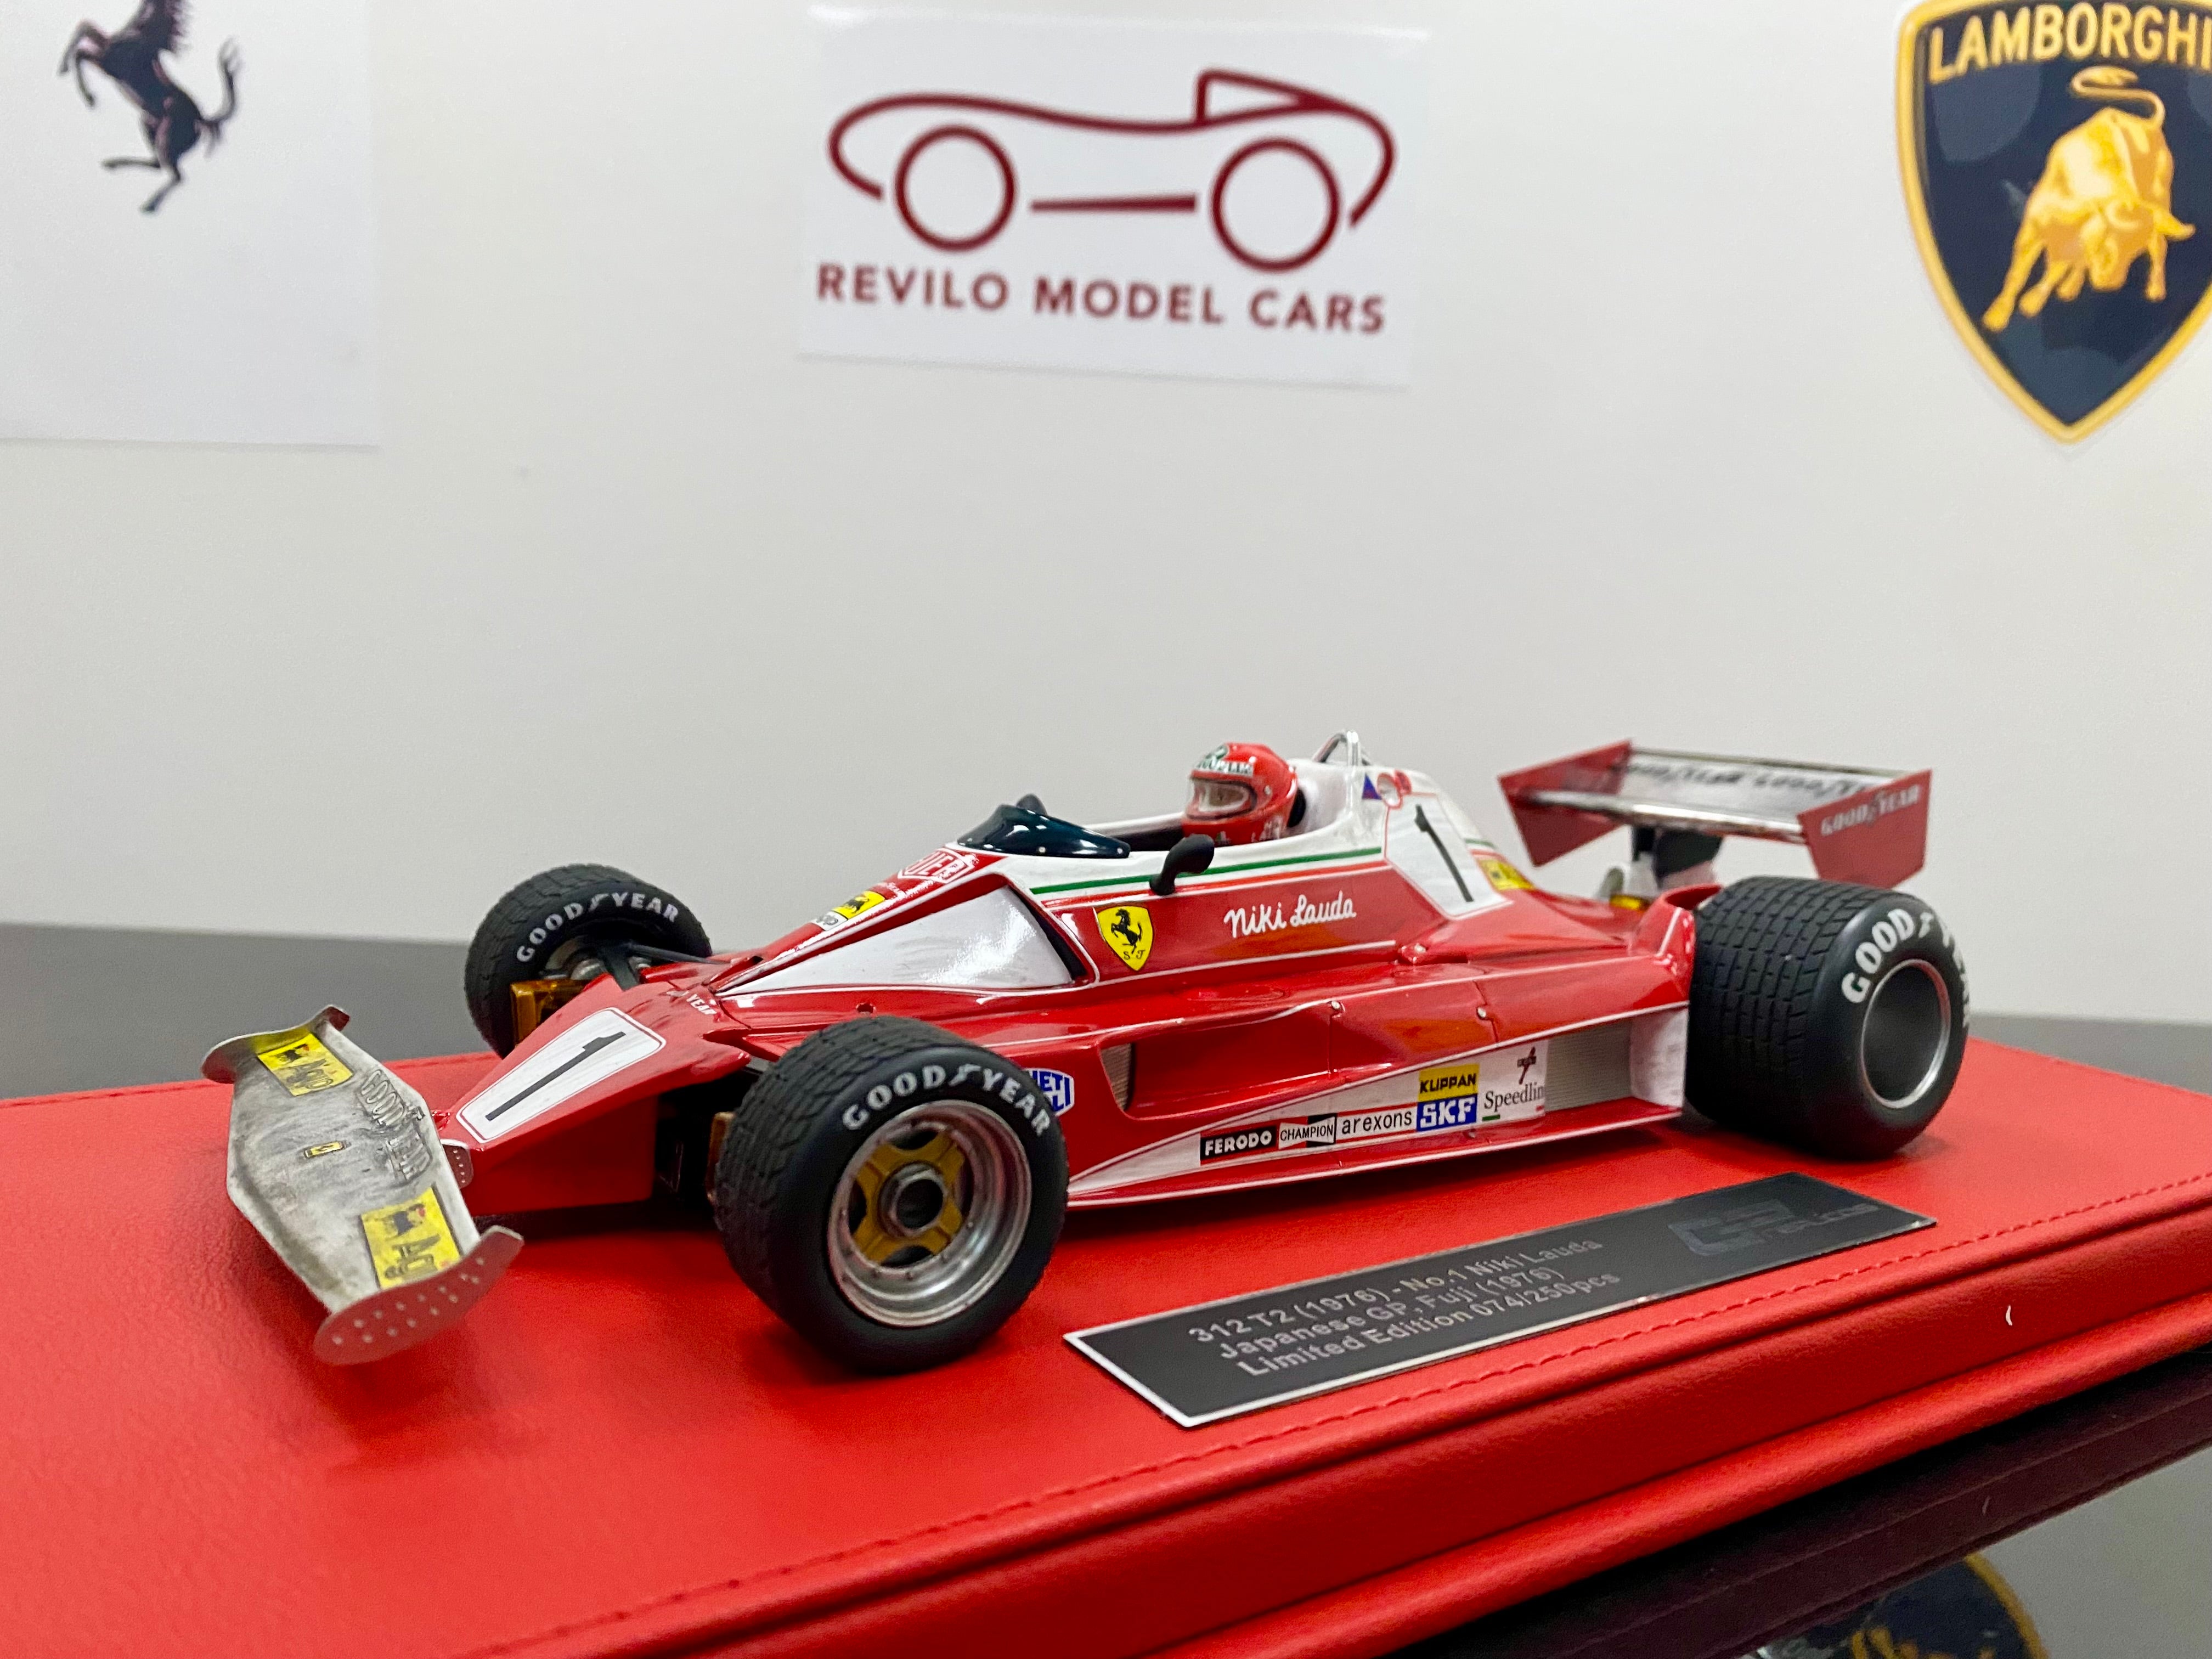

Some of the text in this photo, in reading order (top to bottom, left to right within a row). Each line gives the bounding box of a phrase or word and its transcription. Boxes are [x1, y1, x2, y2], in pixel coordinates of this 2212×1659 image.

[817, 263, 1386, 334] REVILO MODEL CARS
[1414, 804, 1474, 902] 1
[1224, 890, 1357, 938] Niki Lauda
[485, 1031, 626, 1121] 1
[1205, 1131, 1272, 1156] FERODO
[1280, 1125, 1334, 1142] CHAMPION
[1341, 1109, 1413, 1135] arexons
[1420, 1097, 1475, 1127] SKF
[1189, 1319, 1252, 1342] 312
[1247, 1310, 1296, 1327] T2
[1294, 1288, 1391, 1319] (1976)
[1400, 1269, 1468, 1291] No.1
[1464, 1256, 1524, 1276] Niki
[1519, 1240, 1603, 1263] Lauda
[1220, 1315, 1366, 1359] Japanese
[1415, 1286, 1478, 1308] Fuji
[1475, 1267, 1564, 1295] (1976)
[1237, 1274, 1620, 1376] Limited Edition 074/250pcs
